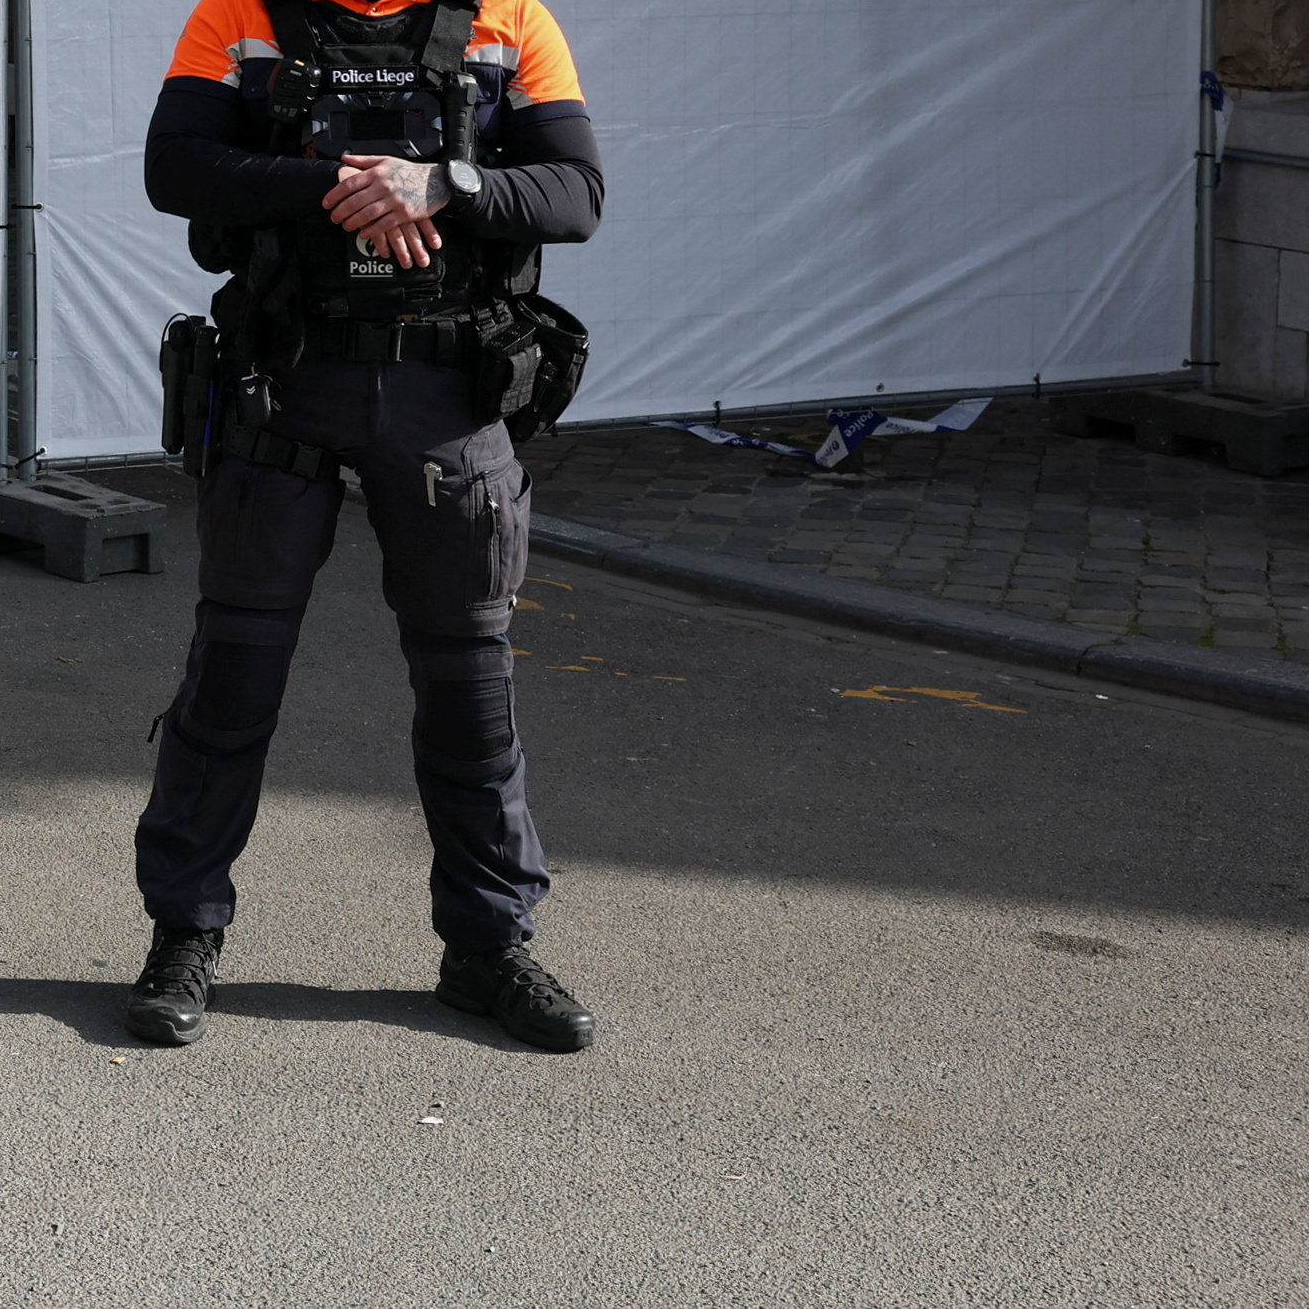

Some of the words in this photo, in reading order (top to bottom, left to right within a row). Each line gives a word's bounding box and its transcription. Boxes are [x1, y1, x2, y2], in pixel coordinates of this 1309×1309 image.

[332, 69, 374, 83] Police
[376, 69, 415, 86] Liege
[349, 260, 394, 275] Police
[844, 409, 875, 438] Police
